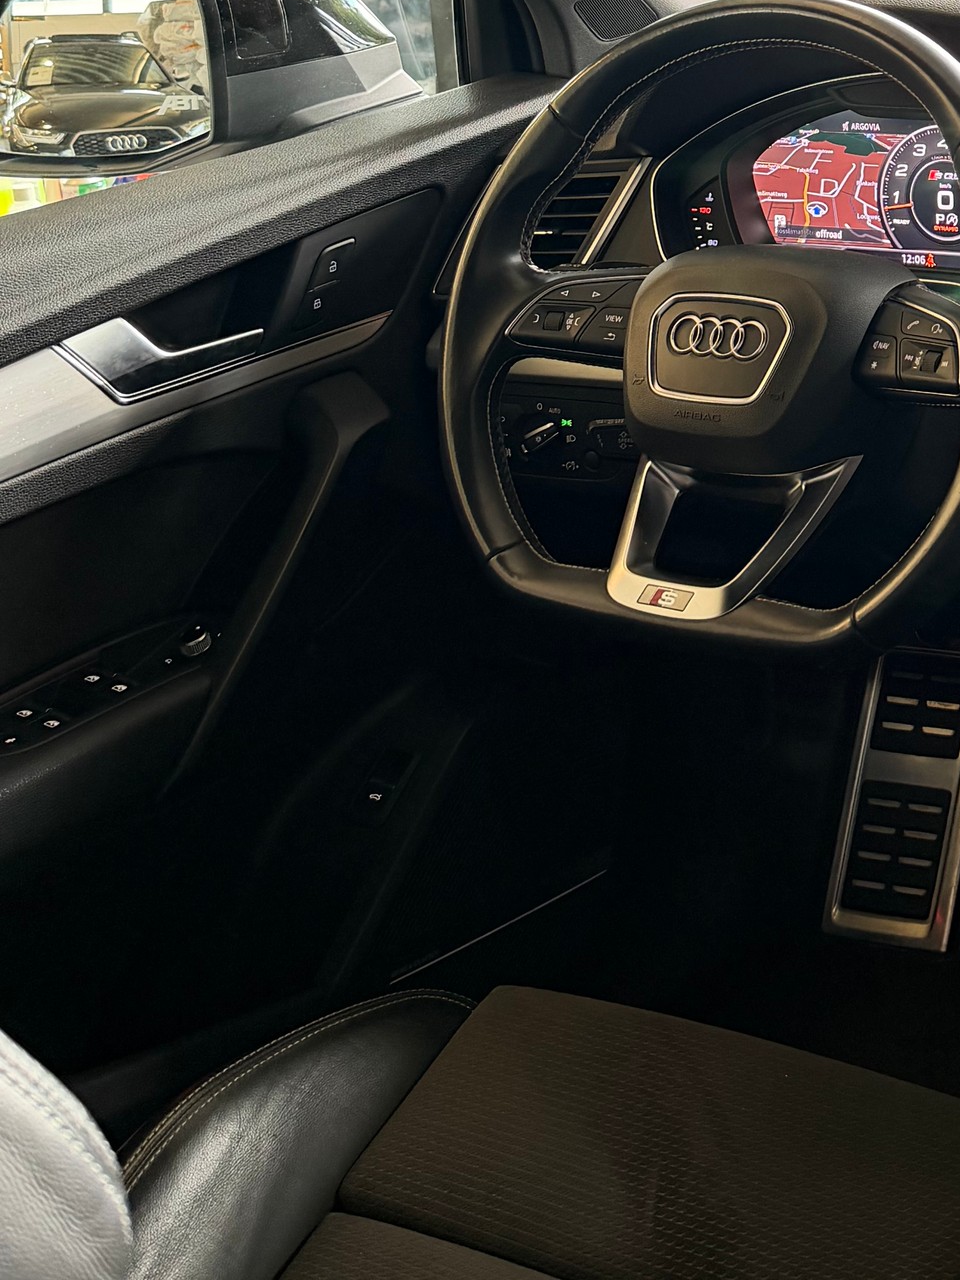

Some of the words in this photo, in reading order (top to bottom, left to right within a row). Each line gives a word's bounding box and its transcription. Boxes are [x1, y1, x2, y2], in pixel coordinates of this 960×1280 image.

[850, 122, 881, 131] ARGOVIA
[912, 144, 926, 156] 3
[895, 164, 908, 177] 2
[893, 190, 900, 204] 1
[937, 190, 954, 210] 0
[935, 213, 945, 225] P
[815, 229, 843, 239] offroad
[901, 254, 926, 265] 12:06
[605, 314, 623, 323] VIEW
